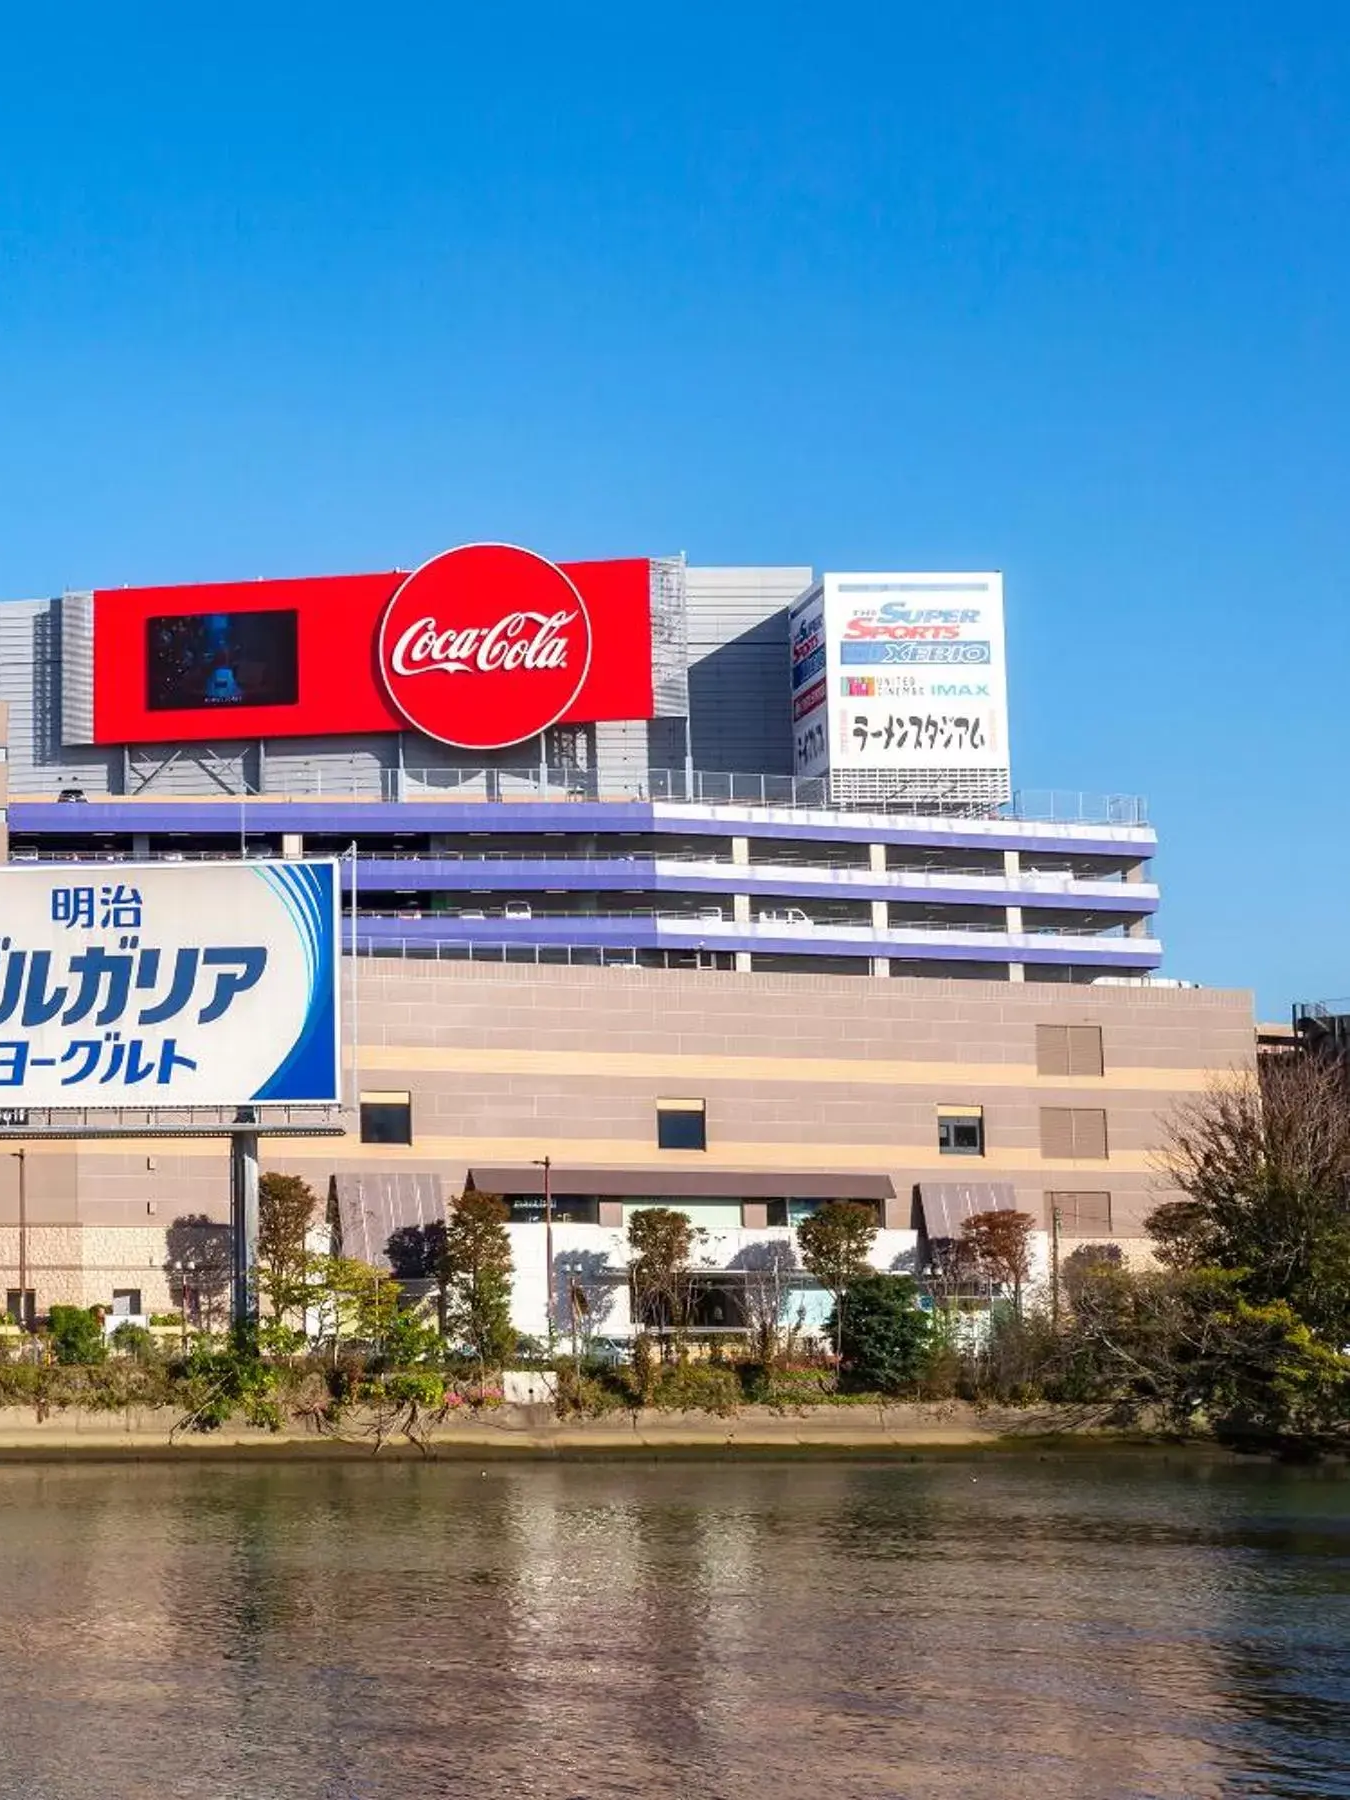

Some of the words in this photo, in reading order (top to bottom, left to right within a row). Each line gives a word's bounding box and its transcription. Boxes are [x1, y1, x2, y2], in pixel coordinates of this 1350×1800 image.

[877, 601, 981, 624] SUPER
[843, 617, 961, 639] SPORTS
[392, 610, 579, 675] Coca-Cola
[882, 642, 989, 664] XEBIO
[931, 684, 991, 696] IMAX
[852, 713, 986, 752] ラーメンスタジアム
[51, 885, 143, 929] 明治
